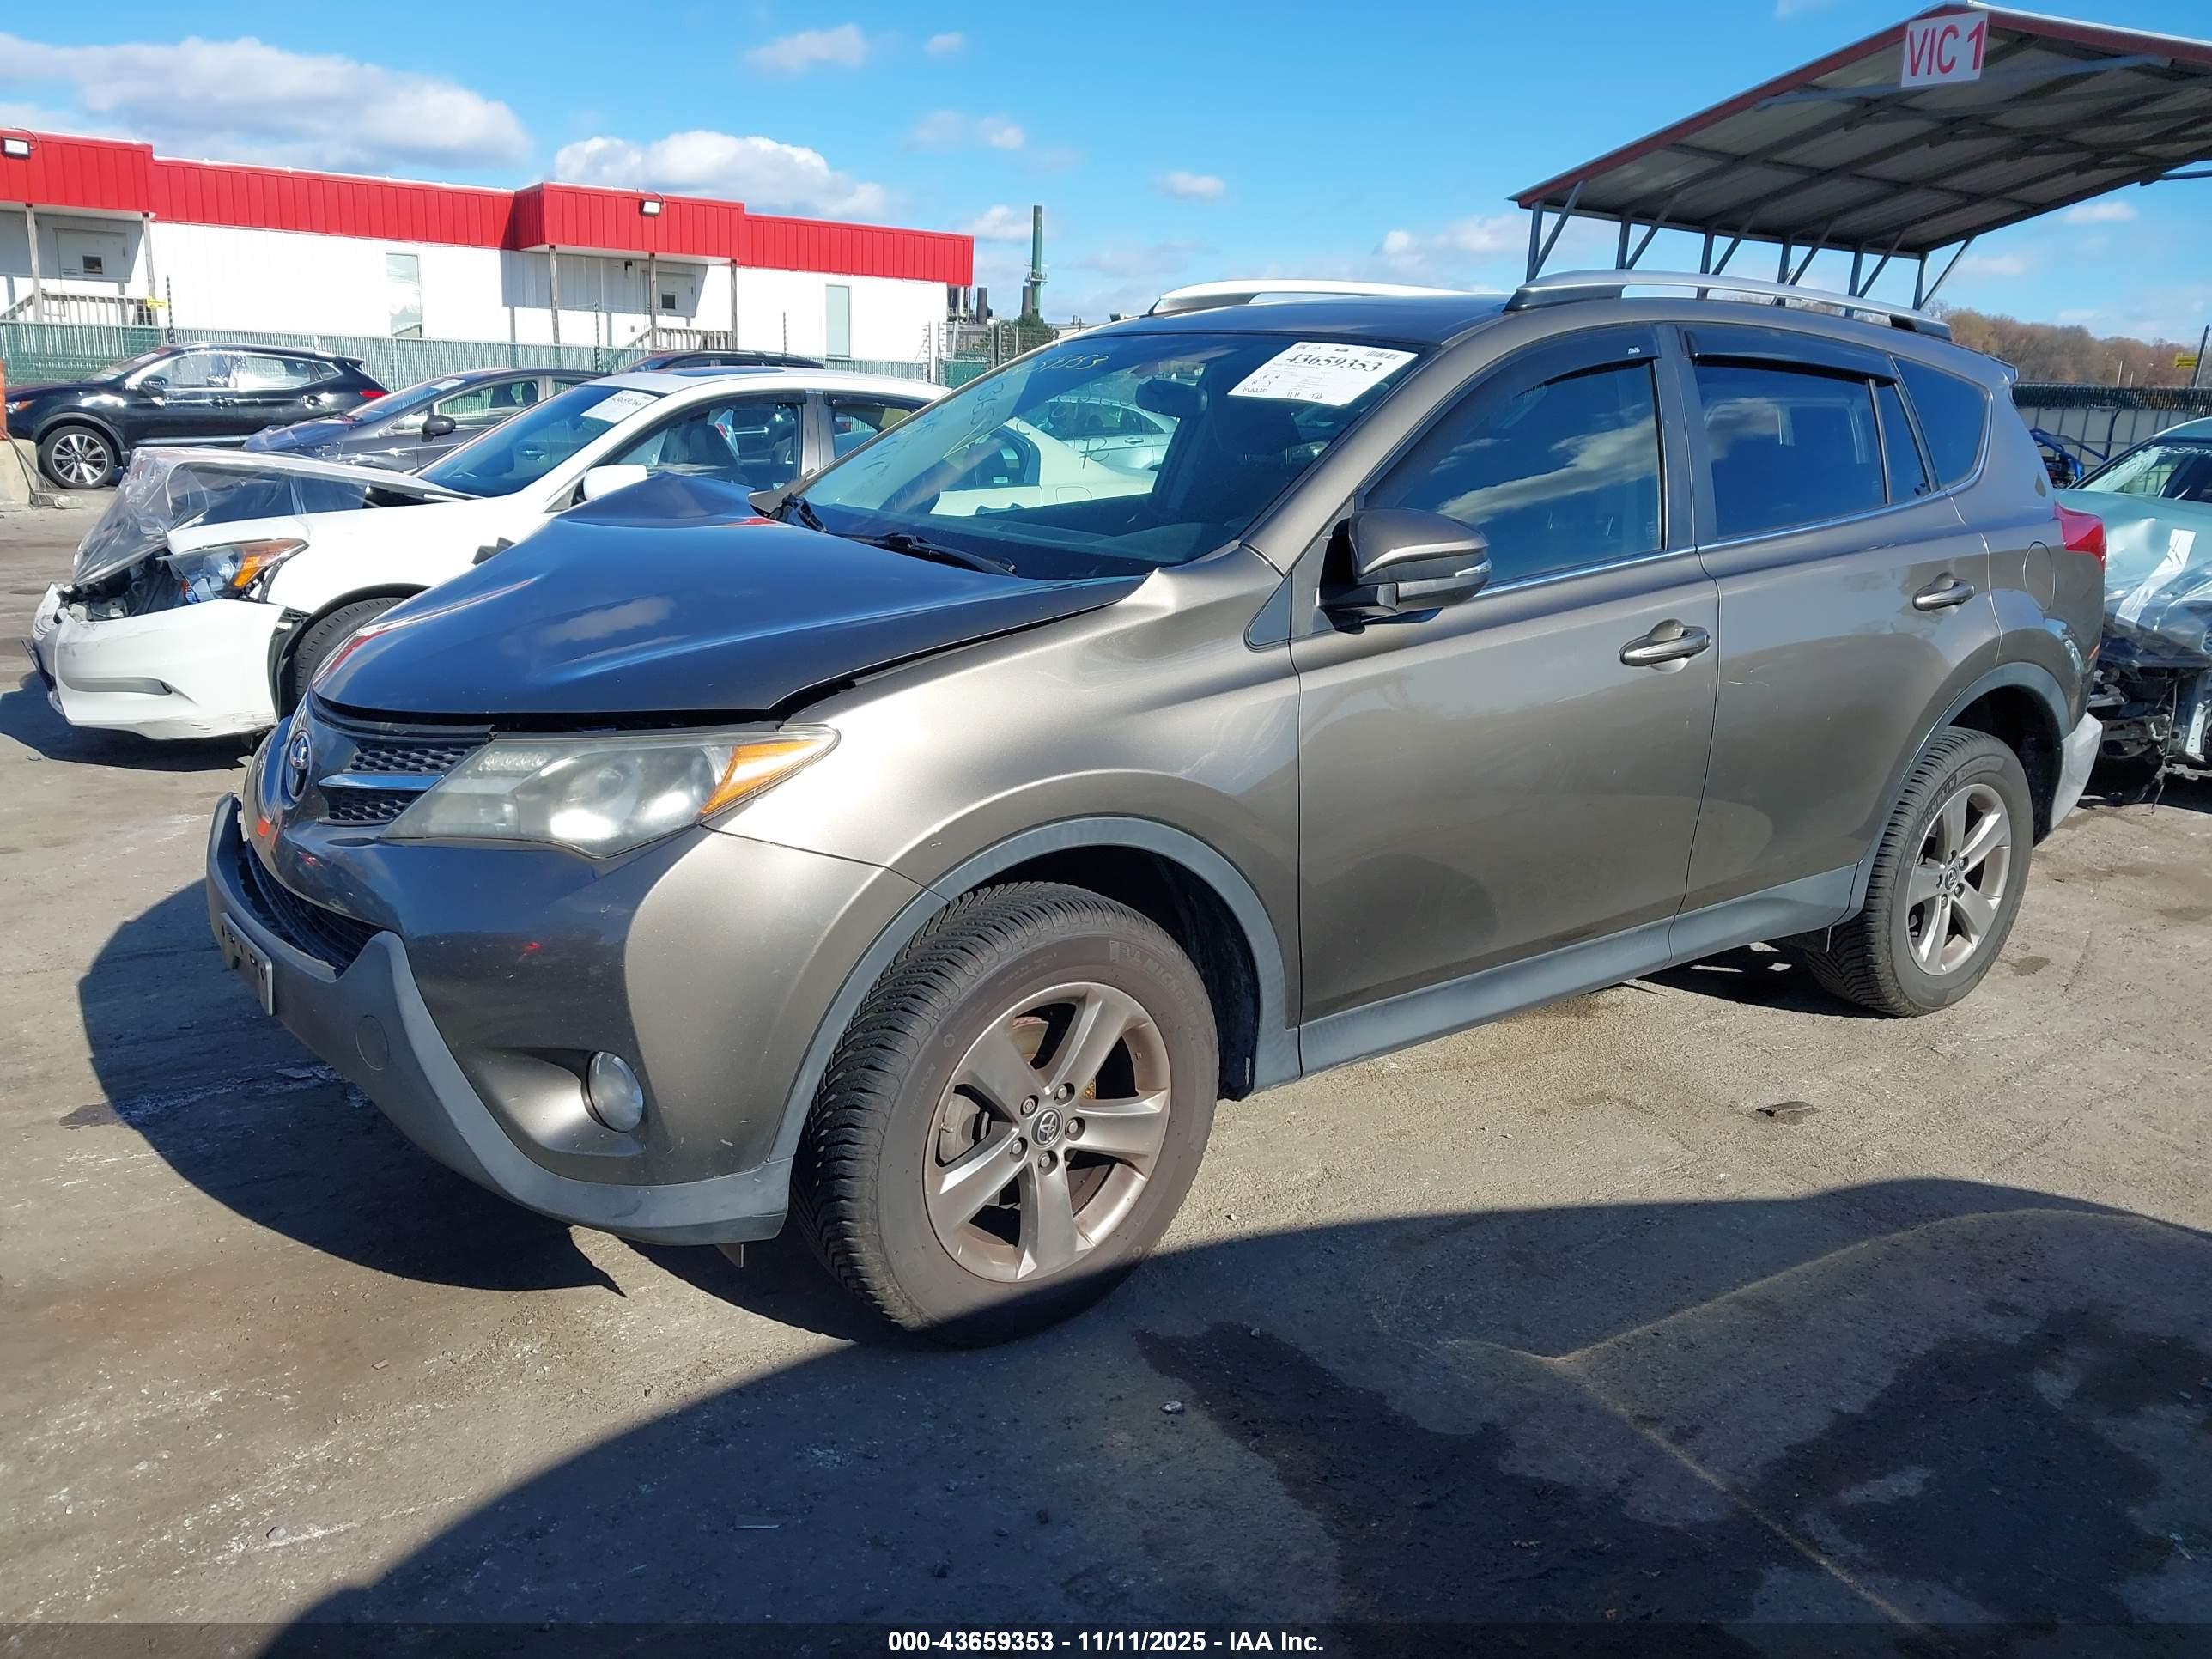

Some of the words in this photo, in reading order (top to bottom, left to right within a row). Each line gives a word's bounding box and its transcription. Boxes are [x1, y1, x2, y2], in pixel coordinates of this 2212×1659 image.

[1909, 24, 1959, 76] VIC
[1967, 21, 1985, 70] 1
[1285, 353, 1382, 372] 43659353
